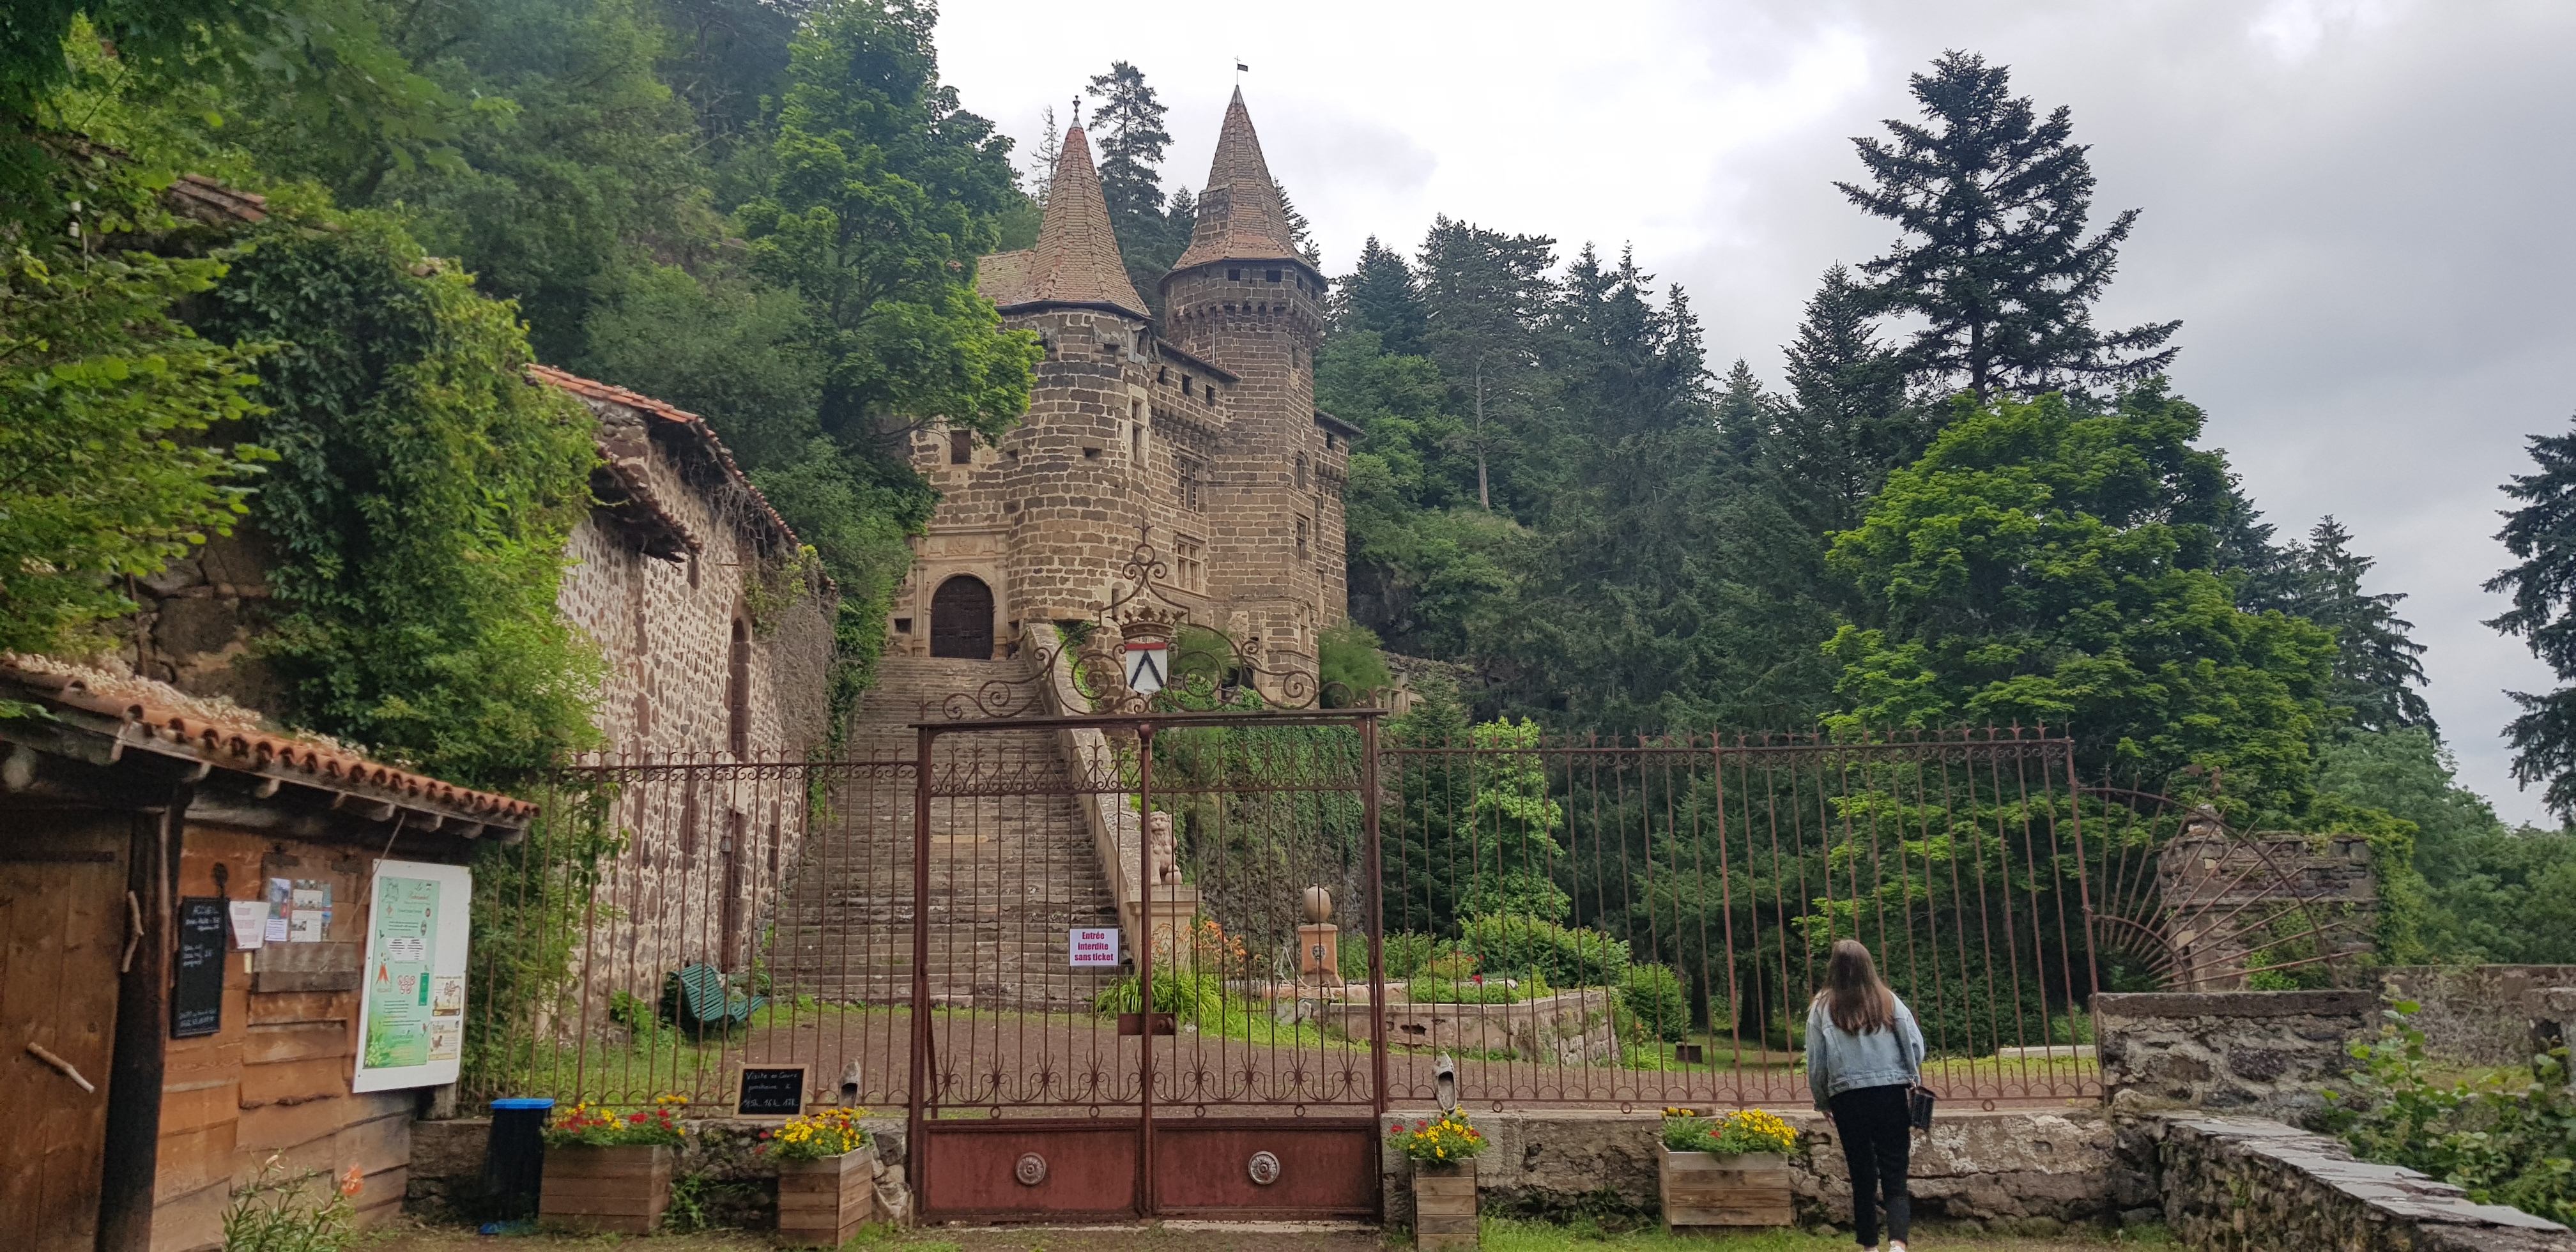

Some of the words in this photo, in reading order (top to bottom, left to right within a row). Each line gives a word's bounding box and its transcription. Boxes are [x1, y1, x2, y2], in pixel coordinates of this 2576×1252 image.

[1082, 931, 1105, 940] Entrée
[1092, 952, 1114, 961] ticket
[746, 1071, 767, 1080] Visite
